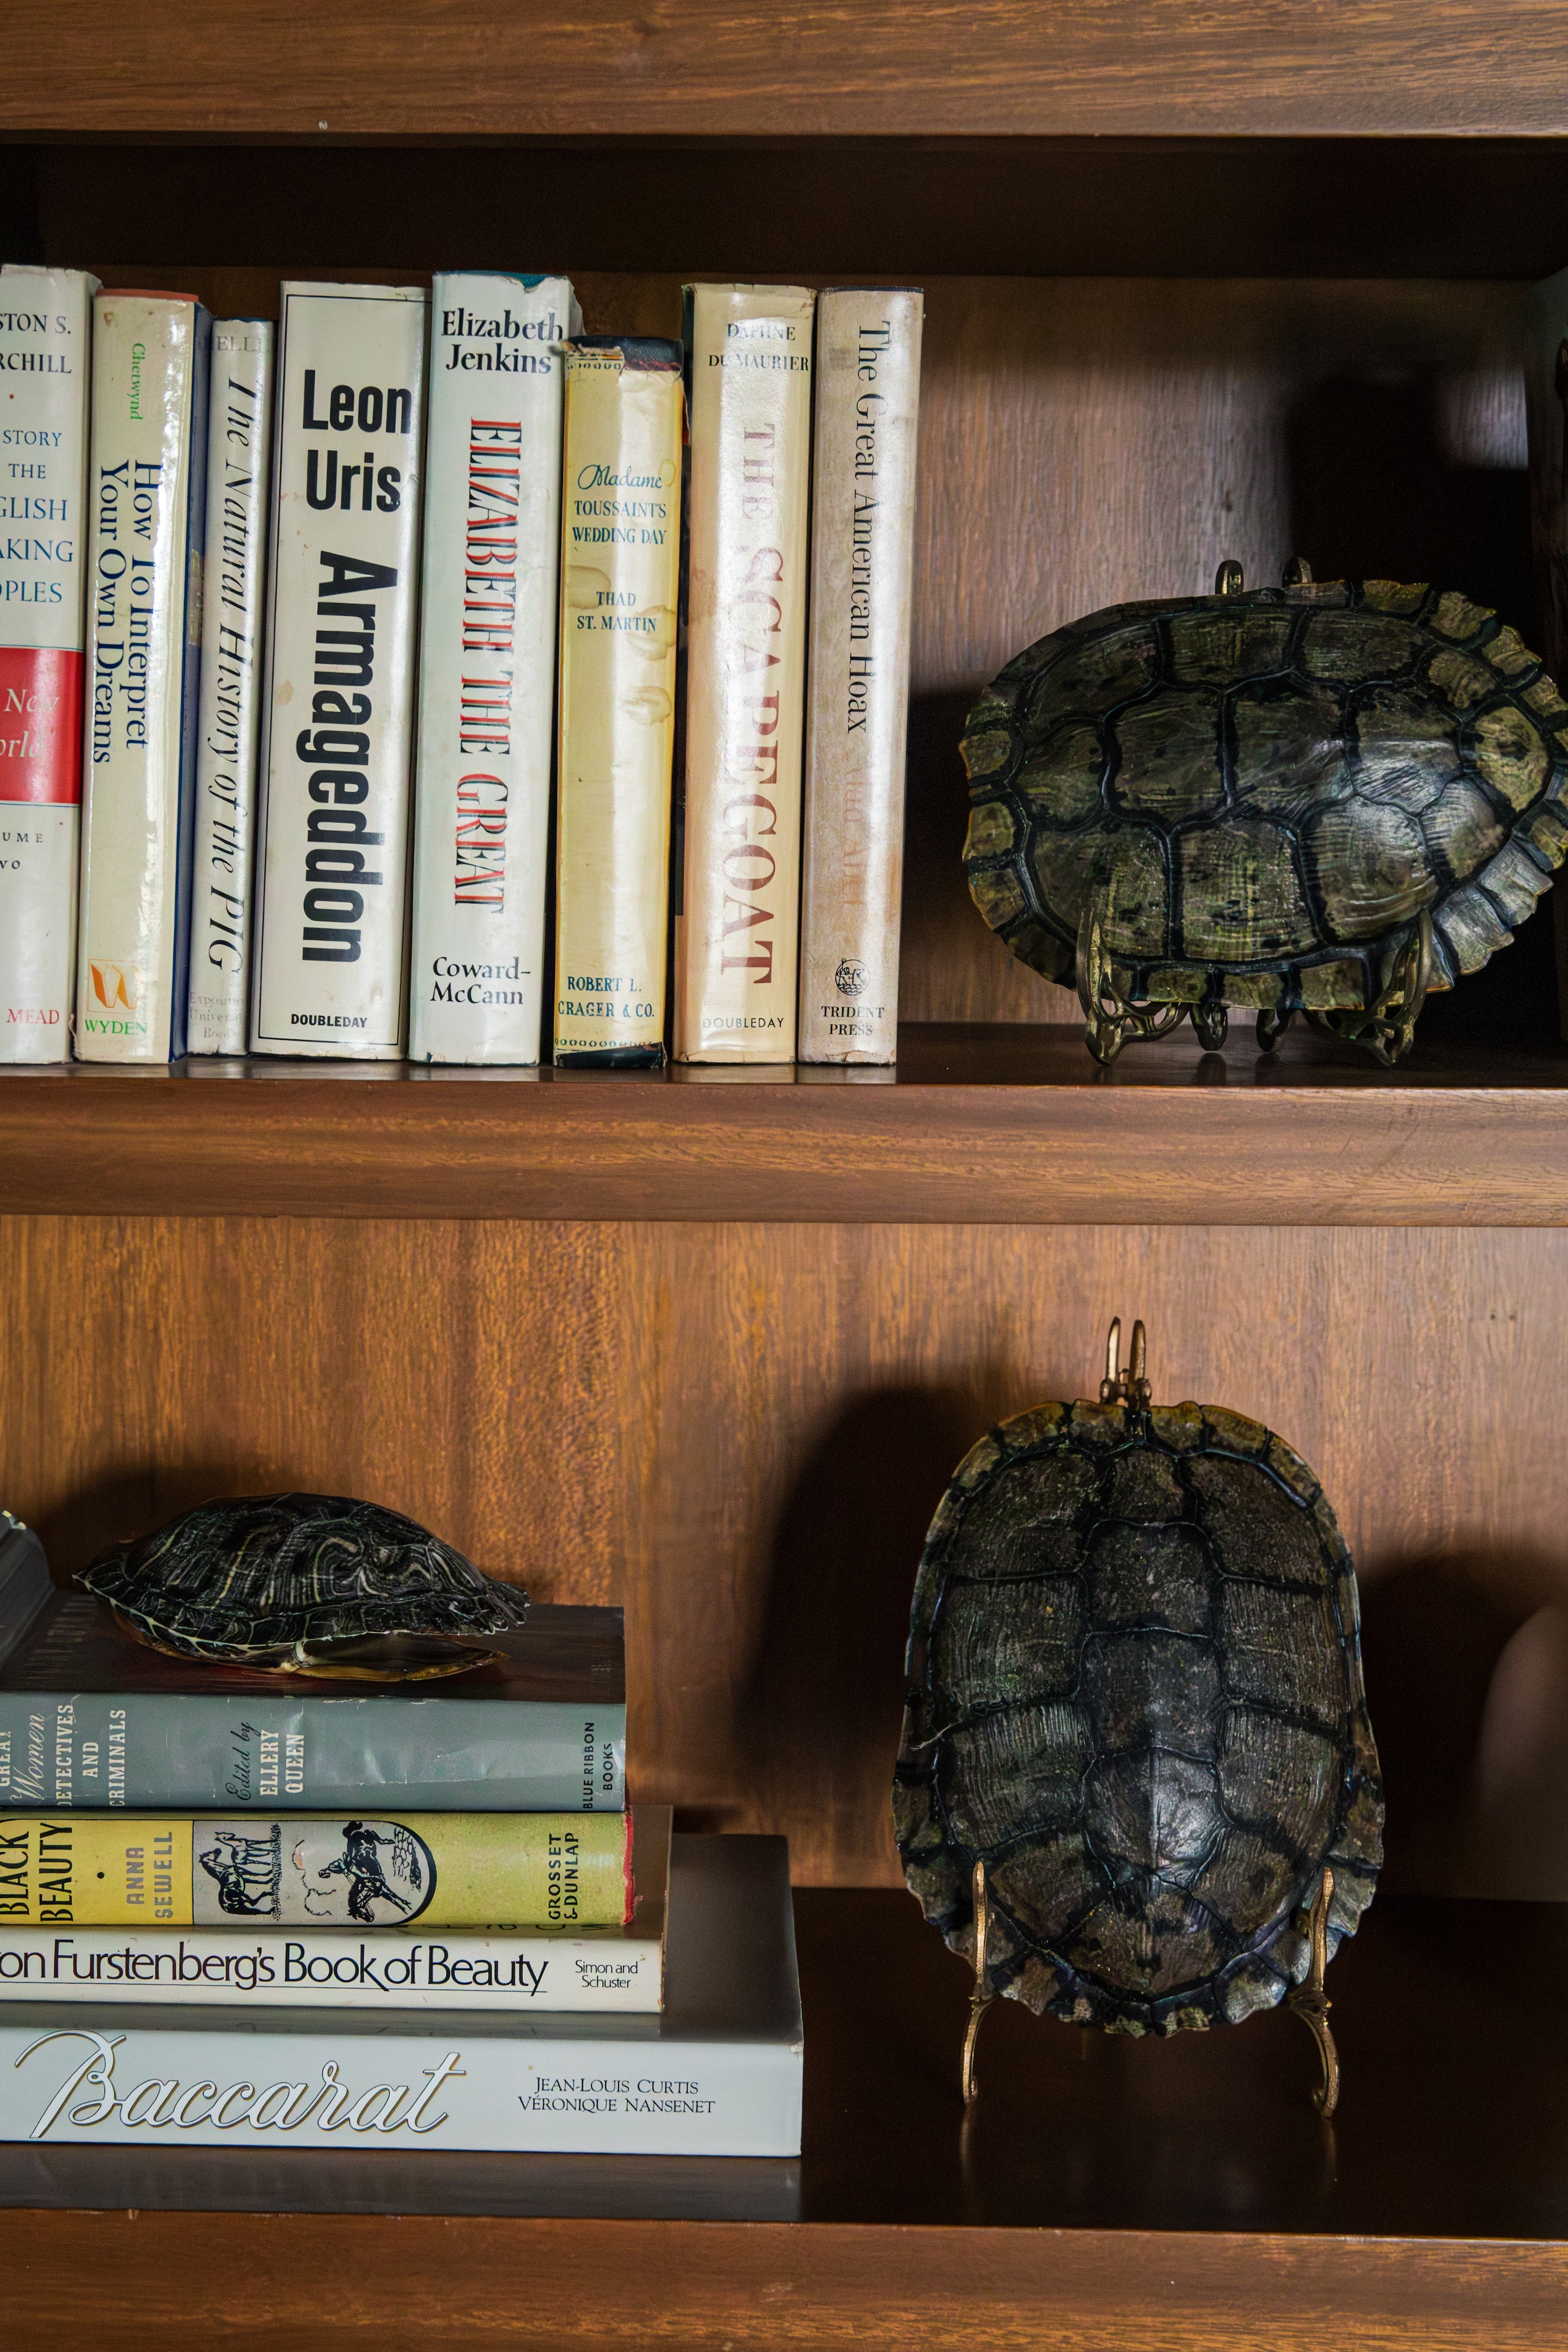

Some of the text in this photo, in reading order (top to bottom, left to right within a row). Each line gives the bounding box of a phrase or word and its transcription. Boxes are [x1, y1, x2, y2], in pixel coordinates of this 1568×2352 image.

[55, 316, 71, 334] S.
[442, 308, 563, 342] Elizabeth
[727, 323, 795, 341] DAPHNE
[446, 343, 552, 374] Jenkins
[709, 354, 809, 371] DU MAURIER
[857, 320, 890, 381] The
[127, 343, 146, 420] Chetwynd
[302, 369, 412, 434] Leon
[3, 430, 62, 446] STORY
[854, 393, 888, 480] Great
[8, 463, 46, 479] THE
[306, 450, 401, 512] Uris
[578, 464, 663, 489] Madame
[574, 500, 666, 518] TOUSSAINT'S
[0, 538, 73, 562] KING
[572, 526, 667, 544] WEDDING DAY
[849, 489, 884, 642] American
[0, 580, 62, 603] PLES
[119, 460, 163, 749] How To Interpret
[596, 591, 636, 606] THAD
[93, 460, 129, 763] Your Own Dreams
[577, 616, 657, 632] ST. MARTIN
[208, 377, 262, 975] The Natural History of the PIG
[454, 416, 522, 915] ELIZABETH THE GREAT
[3, 688, 60, 714] New
[721, 422, 784, 984] THE SCAPEGOAT
[848, 652, 876, 734] Hoax
[296, 550, 398, 963] Armageddon
[3, 832, 44, 843] UME
[432, 956, 531, 981] Coward-
[568, 976, 642, 992] ROBERT L.
[430, 981, 524, 1006] McCann
[558, 1001, 655, 1018] CRAGER & CO.
[5, 1008, 59, 1024] MEAD
[85, 1019, 148, 1034] WYDEN
[291, 1014, 367, 1028] DOUBLEDAY
[702, 1017, 784, 1028] DOUBLEDAY
[821, 1006, 885, 1018] TRIDENT
[829, 1024, 873, 1036] PRESS
[10, 1713, 45, 1802] Women
[82, 1742, 99, 1778] AND
[109, 1710, 126, 1806] CRIMINALS
[225, 1722, 261, 1800] Edited by
[260, 1730, 279, 1795] ELLERY
[285, 1734, 304, 1793] QUEEN
[583, 1723, 595, 1809] BLUE RIBBON
[603, 1743, 613, 1790] BOOKS
[0, 1831, 29, 1915] BLACK
[39, 1822, 74, 1921] BEAUTY
[126, 1848, 145, 1904] ANNA
[154, 1832, 173, 1918] SEWELL
[548, 1834, 561, 1920] GROSSET
[0, 1939, 549, 1996] on Furstenberg's Book of Beauty
[574, 1960, 638, 1974] Simon and
[581, 1975, 631, 1989] Schuster
[14, 2029, 467, 2139] Baccarat
[534, 2077, 699, 2094] JEAN-LOUIS CURTIS
[518, 2096, 715, 2113] VÉRONIQUE NANSENET
